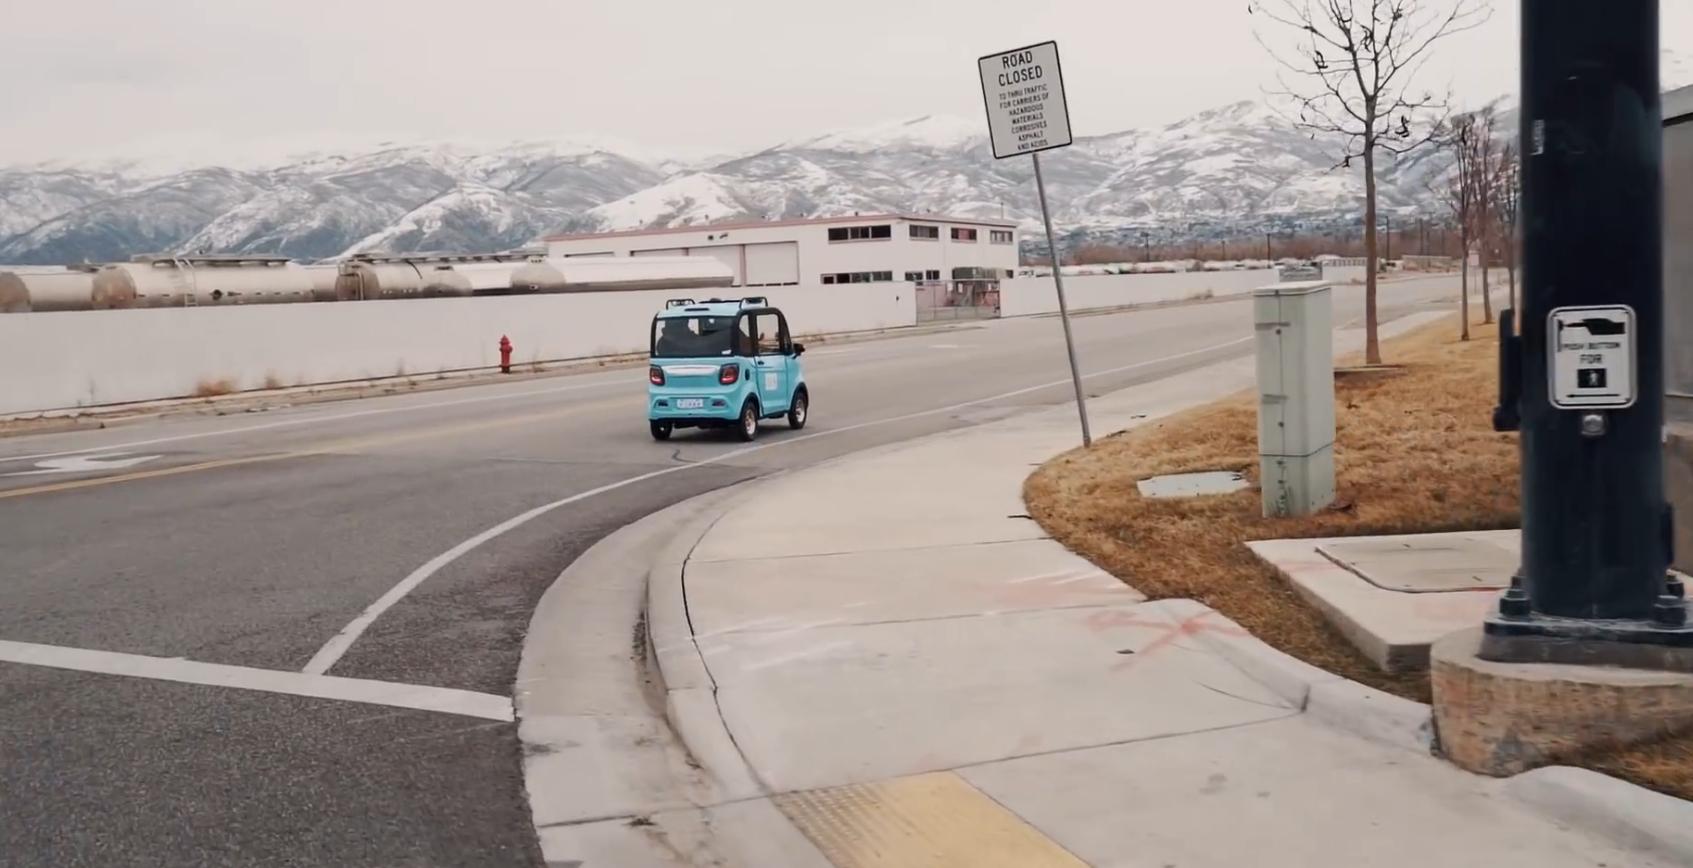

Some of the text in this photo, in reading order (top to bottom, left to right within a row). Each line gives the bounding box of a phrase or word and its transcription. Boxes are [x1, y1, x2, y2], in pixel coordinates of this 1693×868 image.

[1002, 50, 1033, 69] ROAD
[998, 65, 1043, 86] CLOSED
[1024, 83, 1048, 95] TRAFFIC
[1000, 100, 1011, 109] FOR
[1012, 94, 1041, 107] CARRIERS
[1009, 103, 1044, 116] HAZARDOUS
[1012, 112, 1044, 124] MATERIALS
[1011, 121, 1047, 134] CORROSIVES
[1018, 131, 1044, 142] ASPHALT
[1580, 354, 1602, 364] FOR
